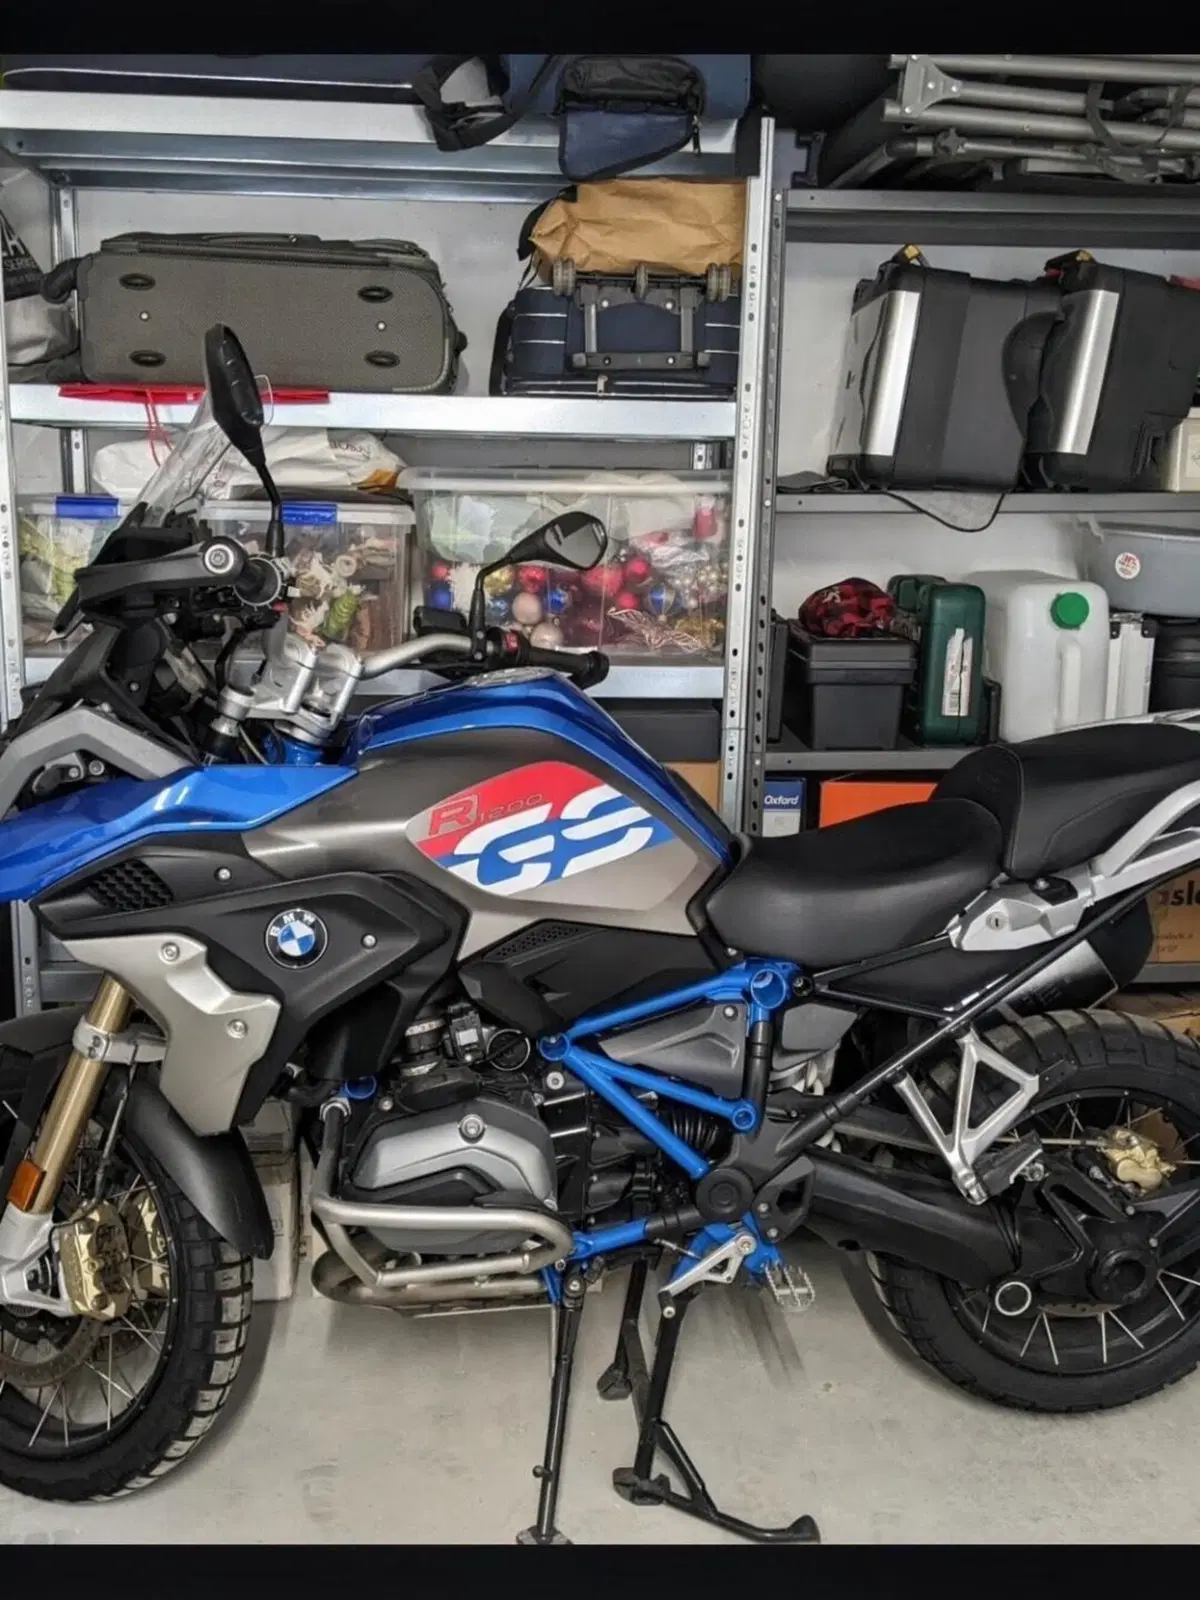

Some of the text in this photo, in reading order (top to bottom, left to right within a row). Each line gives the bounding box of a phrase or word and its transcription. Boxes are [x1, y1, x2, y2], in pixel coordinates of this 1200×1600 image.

[480, 793, 544, 823] 1200
[764, 794, 800, 805] Oxford
[447, 783, 654, 896] GS
[269, 911, 318, 937] BMW
